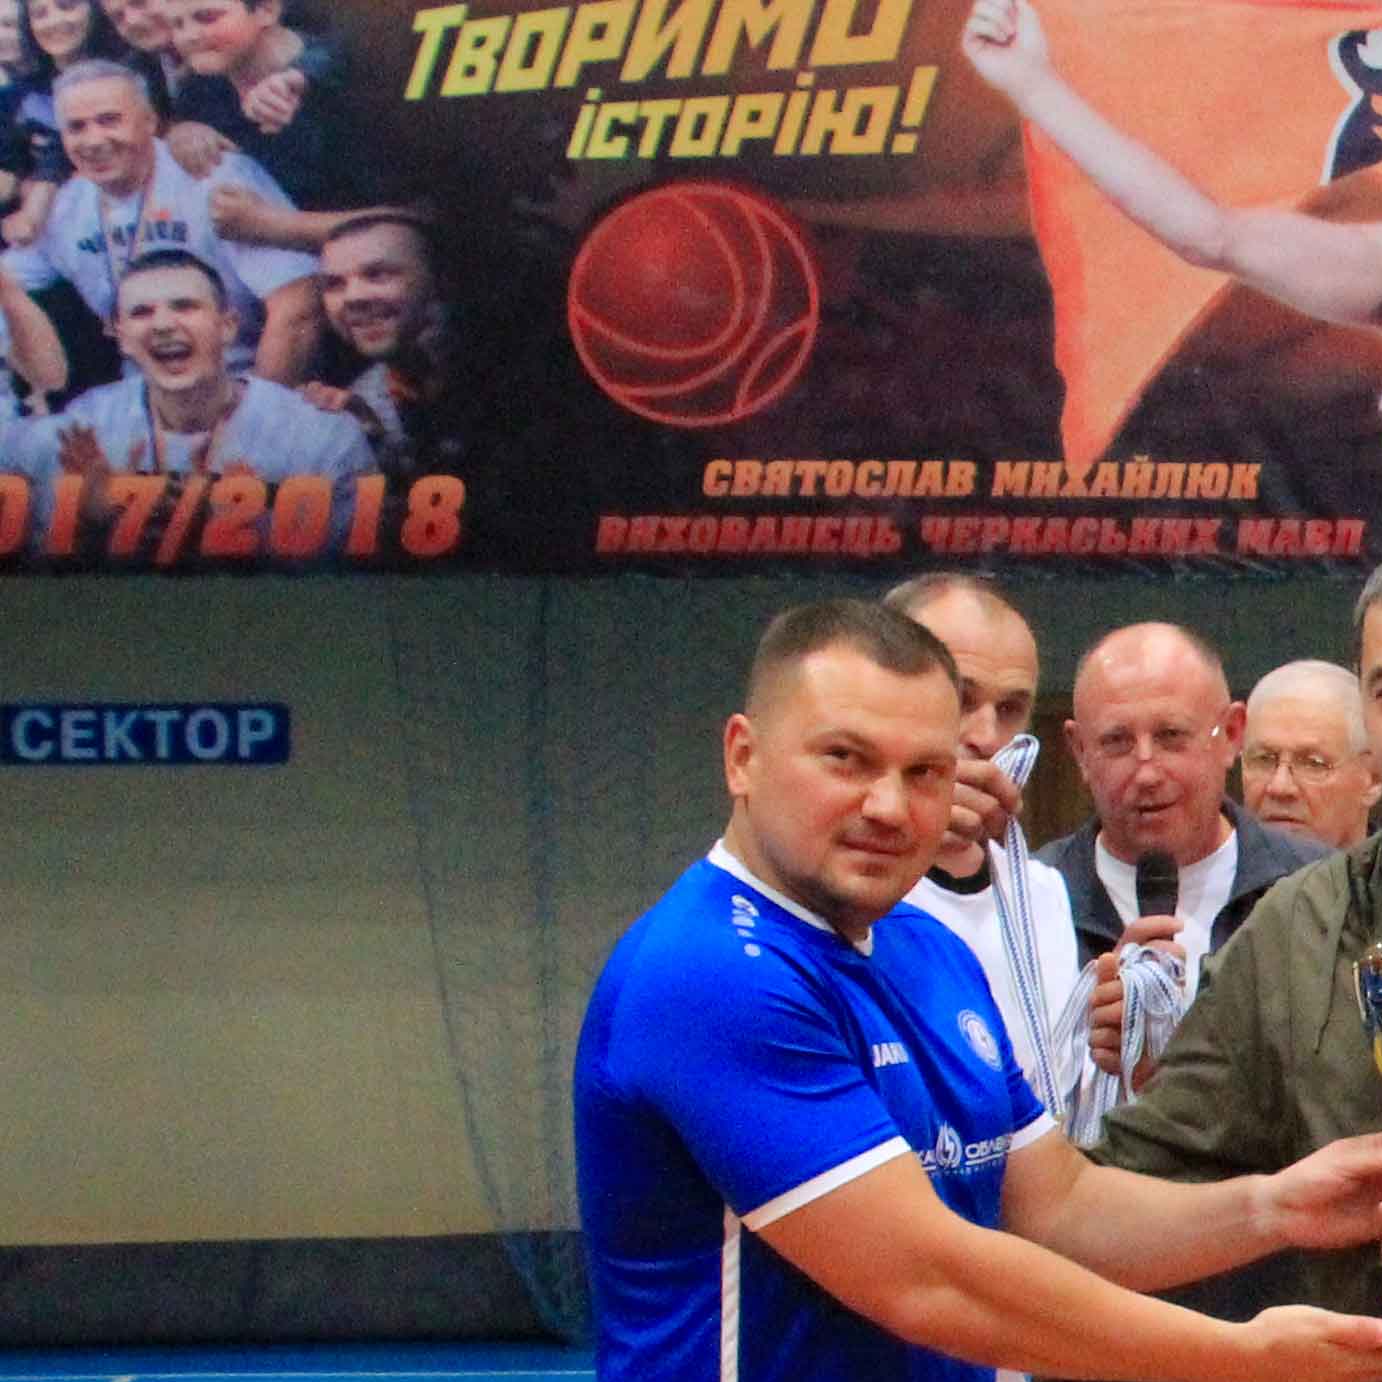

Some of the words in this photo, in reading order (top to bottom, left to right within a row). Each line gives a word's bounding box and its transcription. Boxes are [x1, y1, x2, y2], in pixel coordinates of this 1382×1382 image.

[702, 458, 976, 498] СВЯТОСЛАВ
[991, 454, 1262, 500] МИХАЙЛЮК
[1237, 517, 1366, 556] МАВП
[11, 708, 276, 760] СЕКТОР
